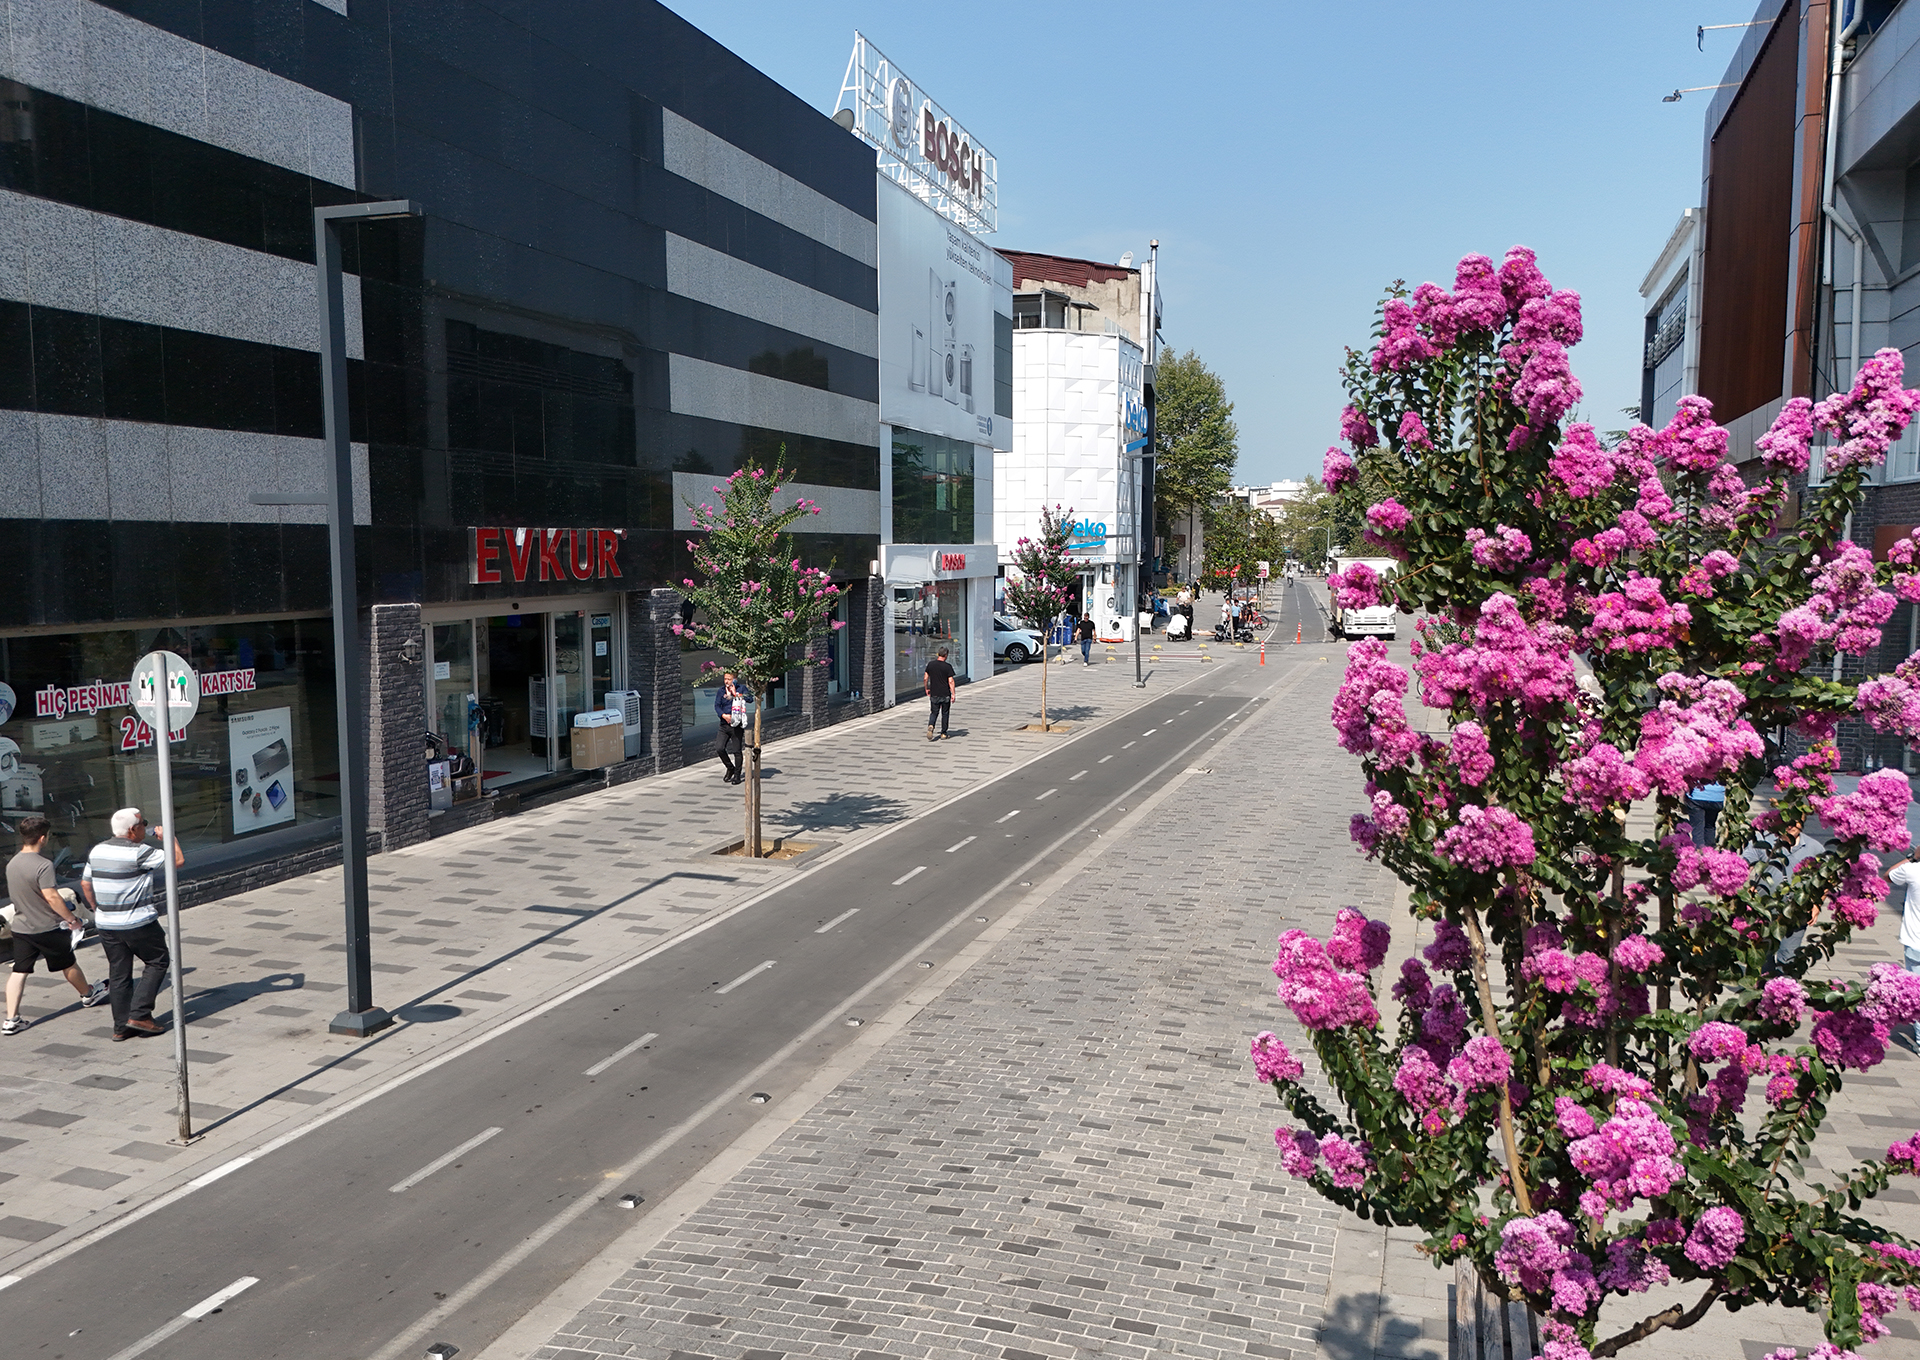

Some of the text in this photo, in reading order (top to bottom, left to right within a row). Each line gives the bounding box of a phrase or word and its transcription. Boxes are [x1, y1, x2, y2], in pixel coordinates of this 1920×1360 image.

[919, 106, 982, 200] BOSCH
[1123, 391, 1148, 434] beko
[468, 527, 623, 583] EVKUR
[36, 684, 66, 719] HİÇ
[67, 679, 133, 715] PEŞİNAT
[201, 668, 256, 697] KARTSIZ
[121, 716, 154, 750] 24
[230, 715, 254, 723] SAMSUNG
